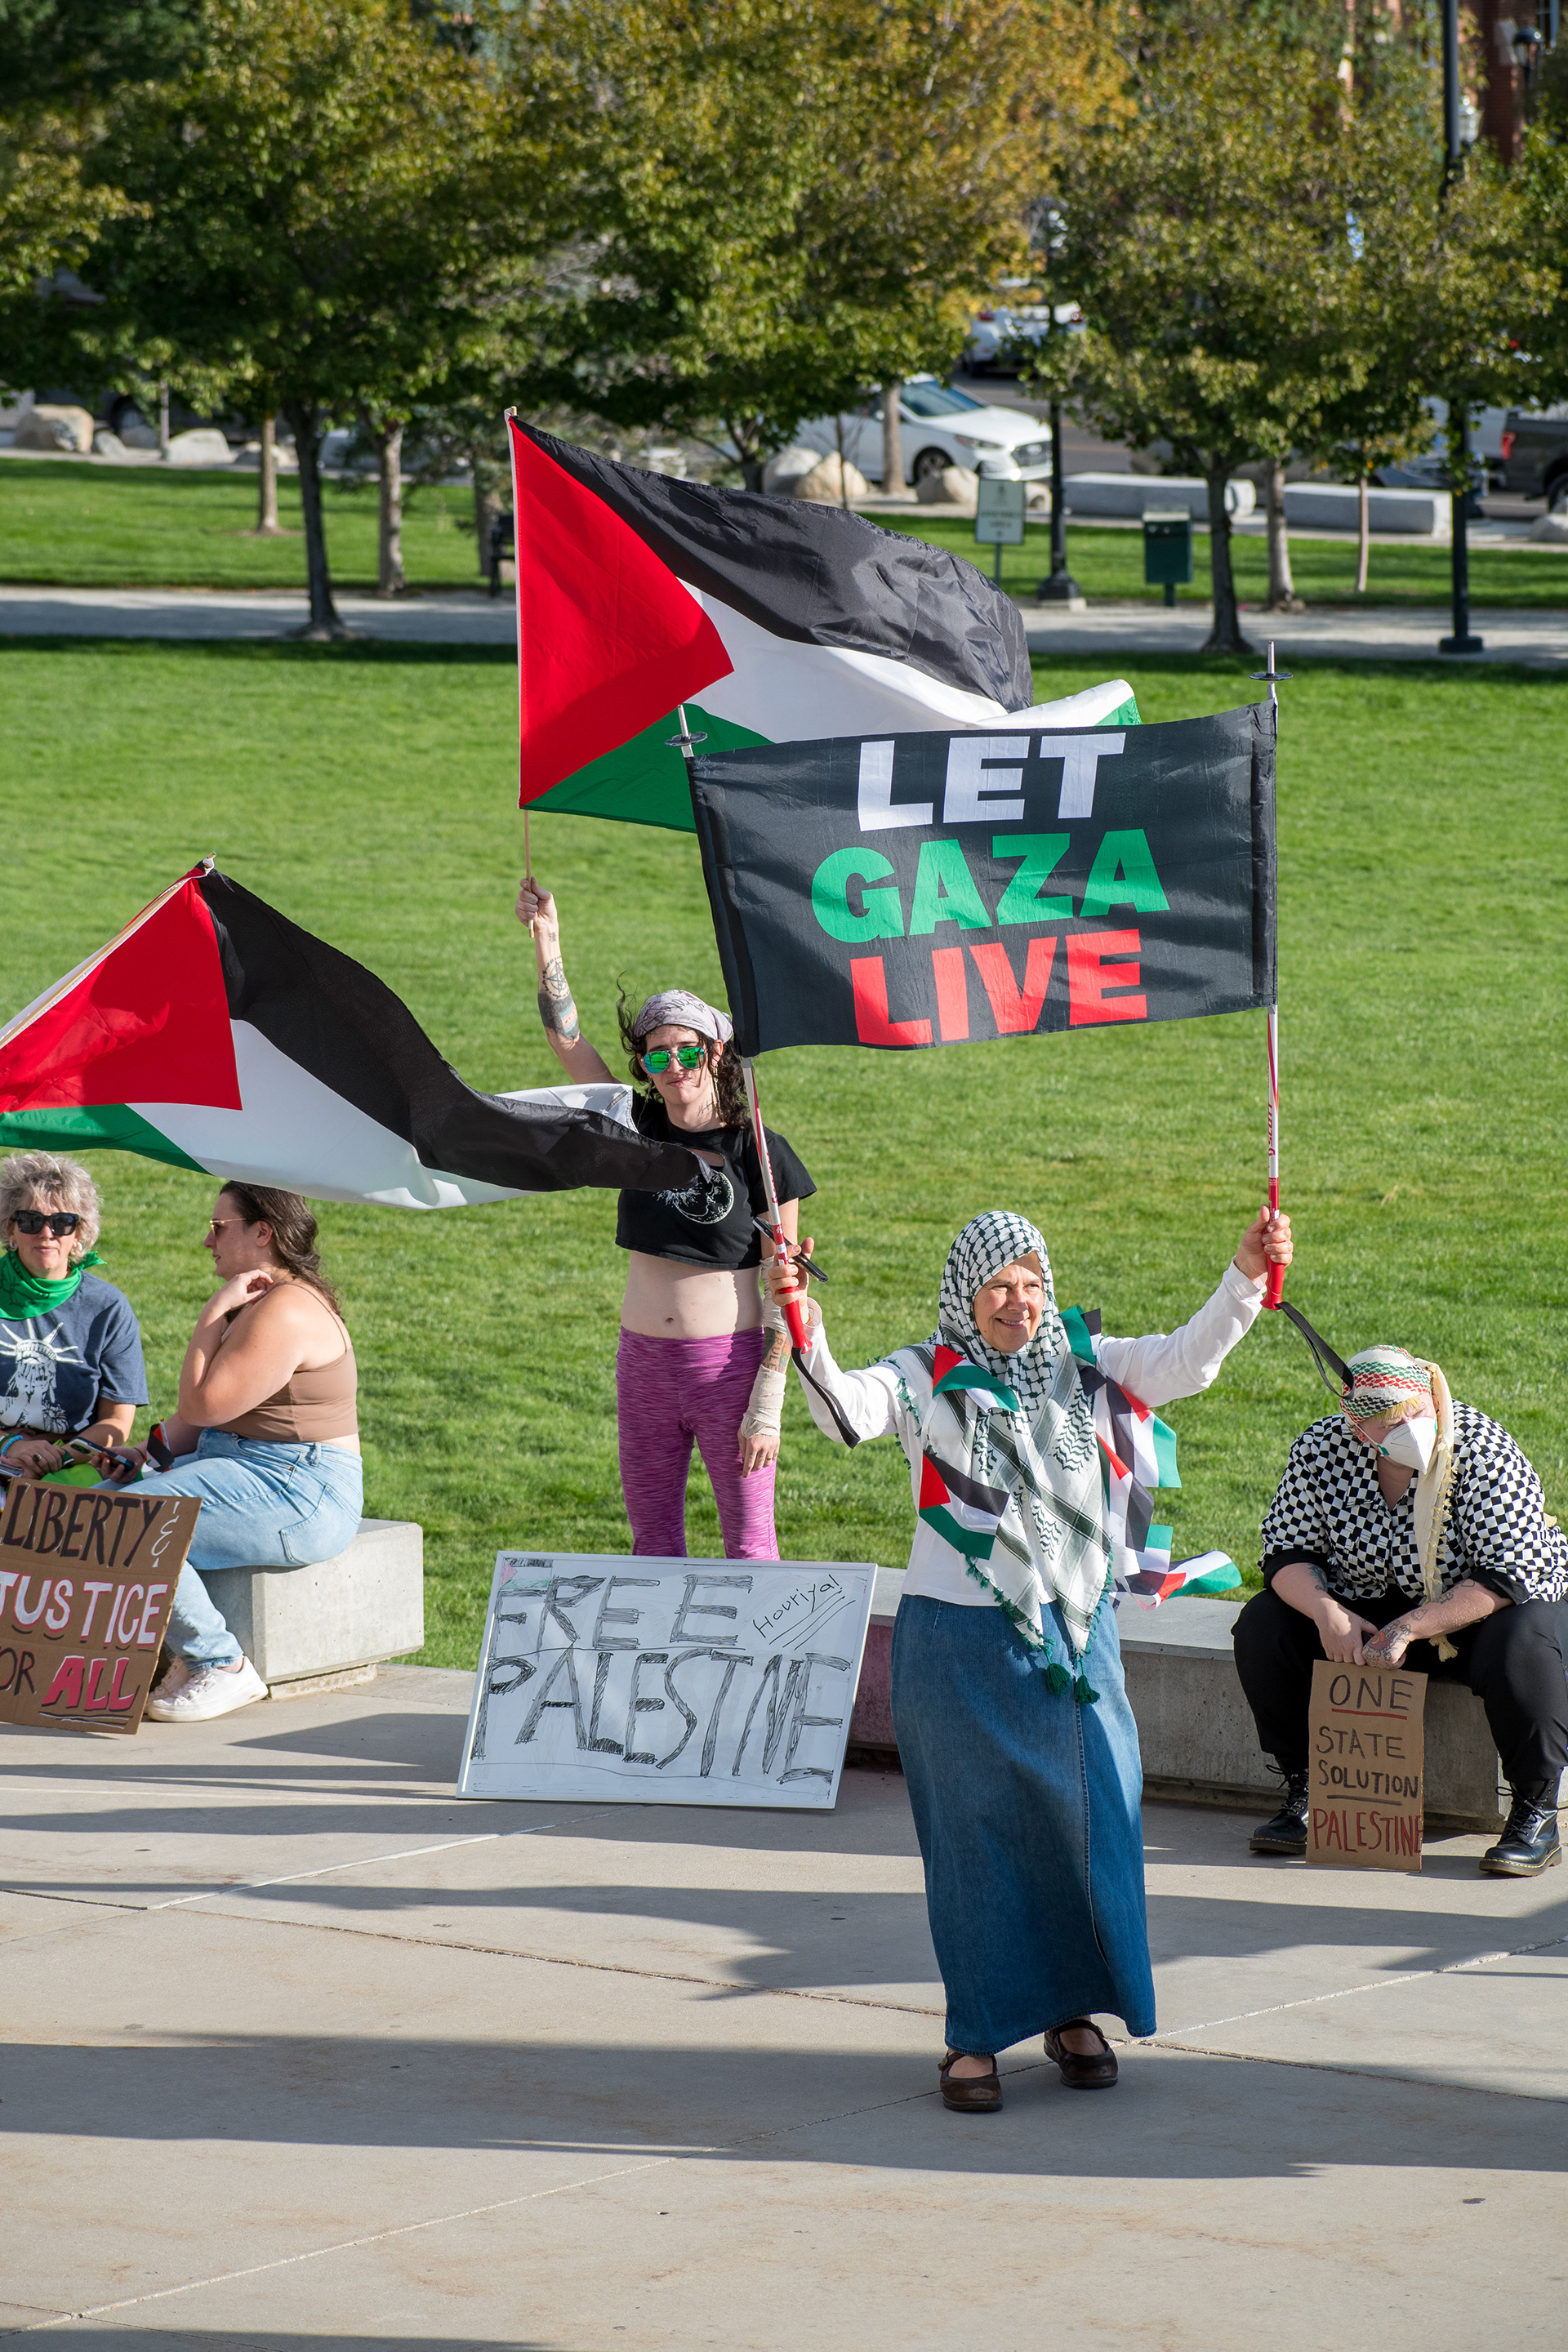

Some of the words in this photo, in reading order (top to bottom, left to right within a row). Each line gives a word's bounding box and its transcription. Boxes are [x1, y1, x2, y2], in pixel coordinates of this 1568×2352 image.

[858, 733, 1126, 832] LET
[811, 829, 1170, 943] GAZA
[850, 929, 1147, 1046] LIVE
[3, 1484, 166, 1568] LIBERTY
[489, 1575, 754, 1659] FREE
[0, 1646, 37, 1696] OR
[42, 1655, 140, 1713] ALL
[470, 1644, 851, 1784] PALESTINE
[1329, 1674, 1414, 1711] ONE
[1316, 1725, 1406, 1760] STATE
[1318, 1759, 1419, 1799] SOLUTION
[1312, 1807, 1424, 1857] PALESTINE
